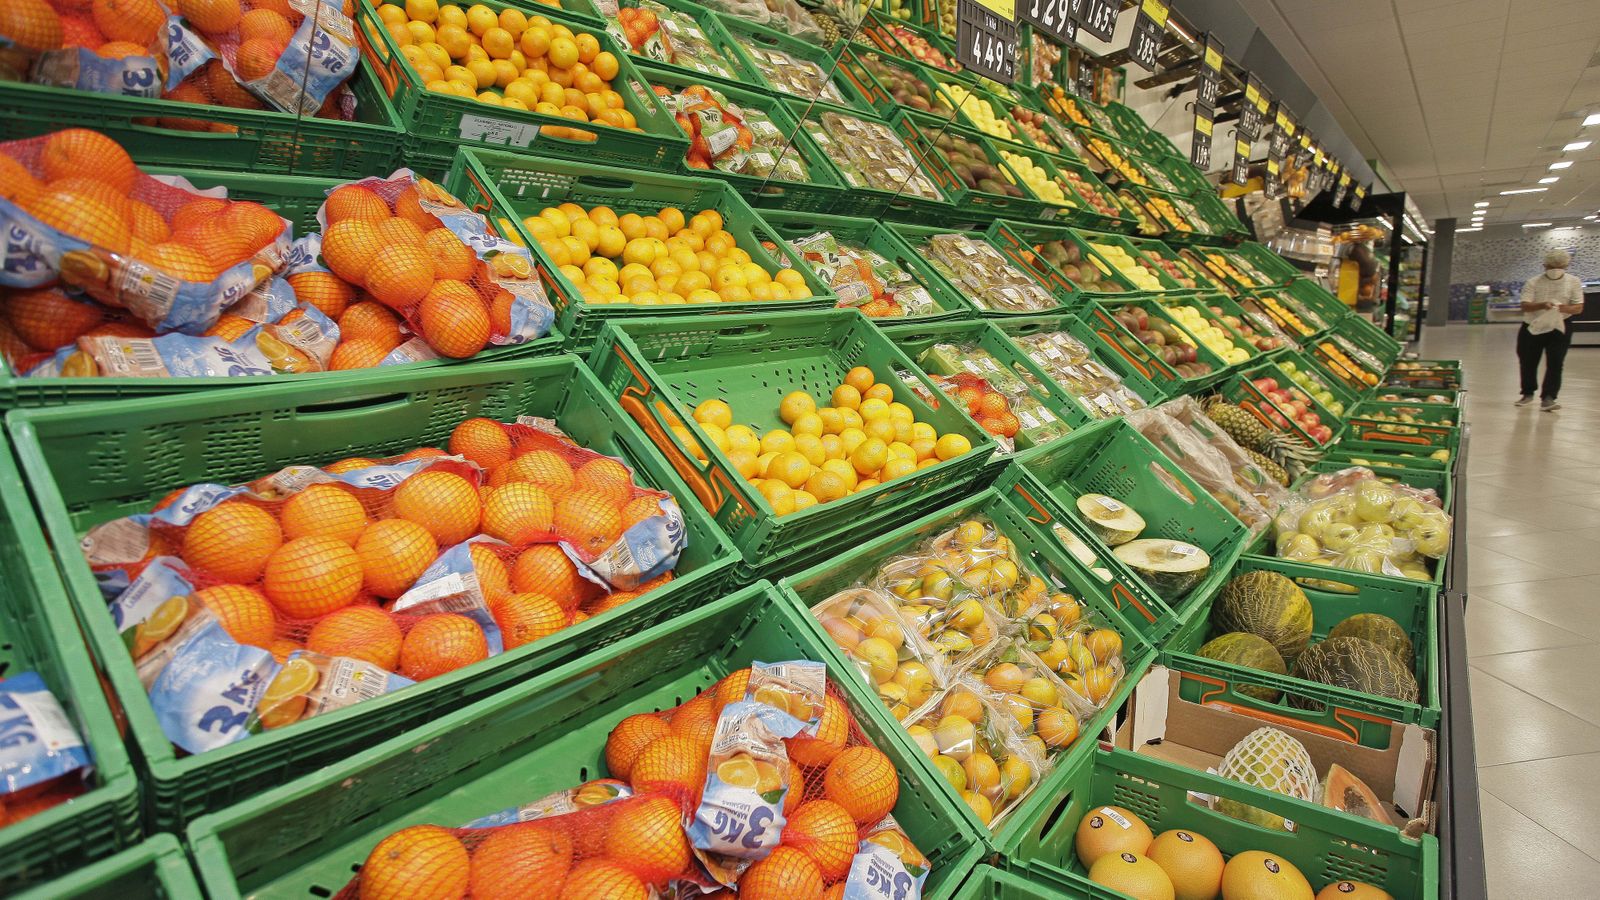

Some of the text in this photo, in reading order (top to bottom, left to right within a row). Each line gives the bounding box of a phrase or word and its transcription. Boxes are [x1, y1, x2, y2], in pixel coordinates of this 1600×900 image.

[1087, 0, 1112, 32] 165
[973, 31, 1003, 73] 449
[1136, 33, 1155, 64] 385
[198, 705, 249, 735] 3
[711, 806, 775, 849] 3 KG
[866, 865, 892, 899] KG
